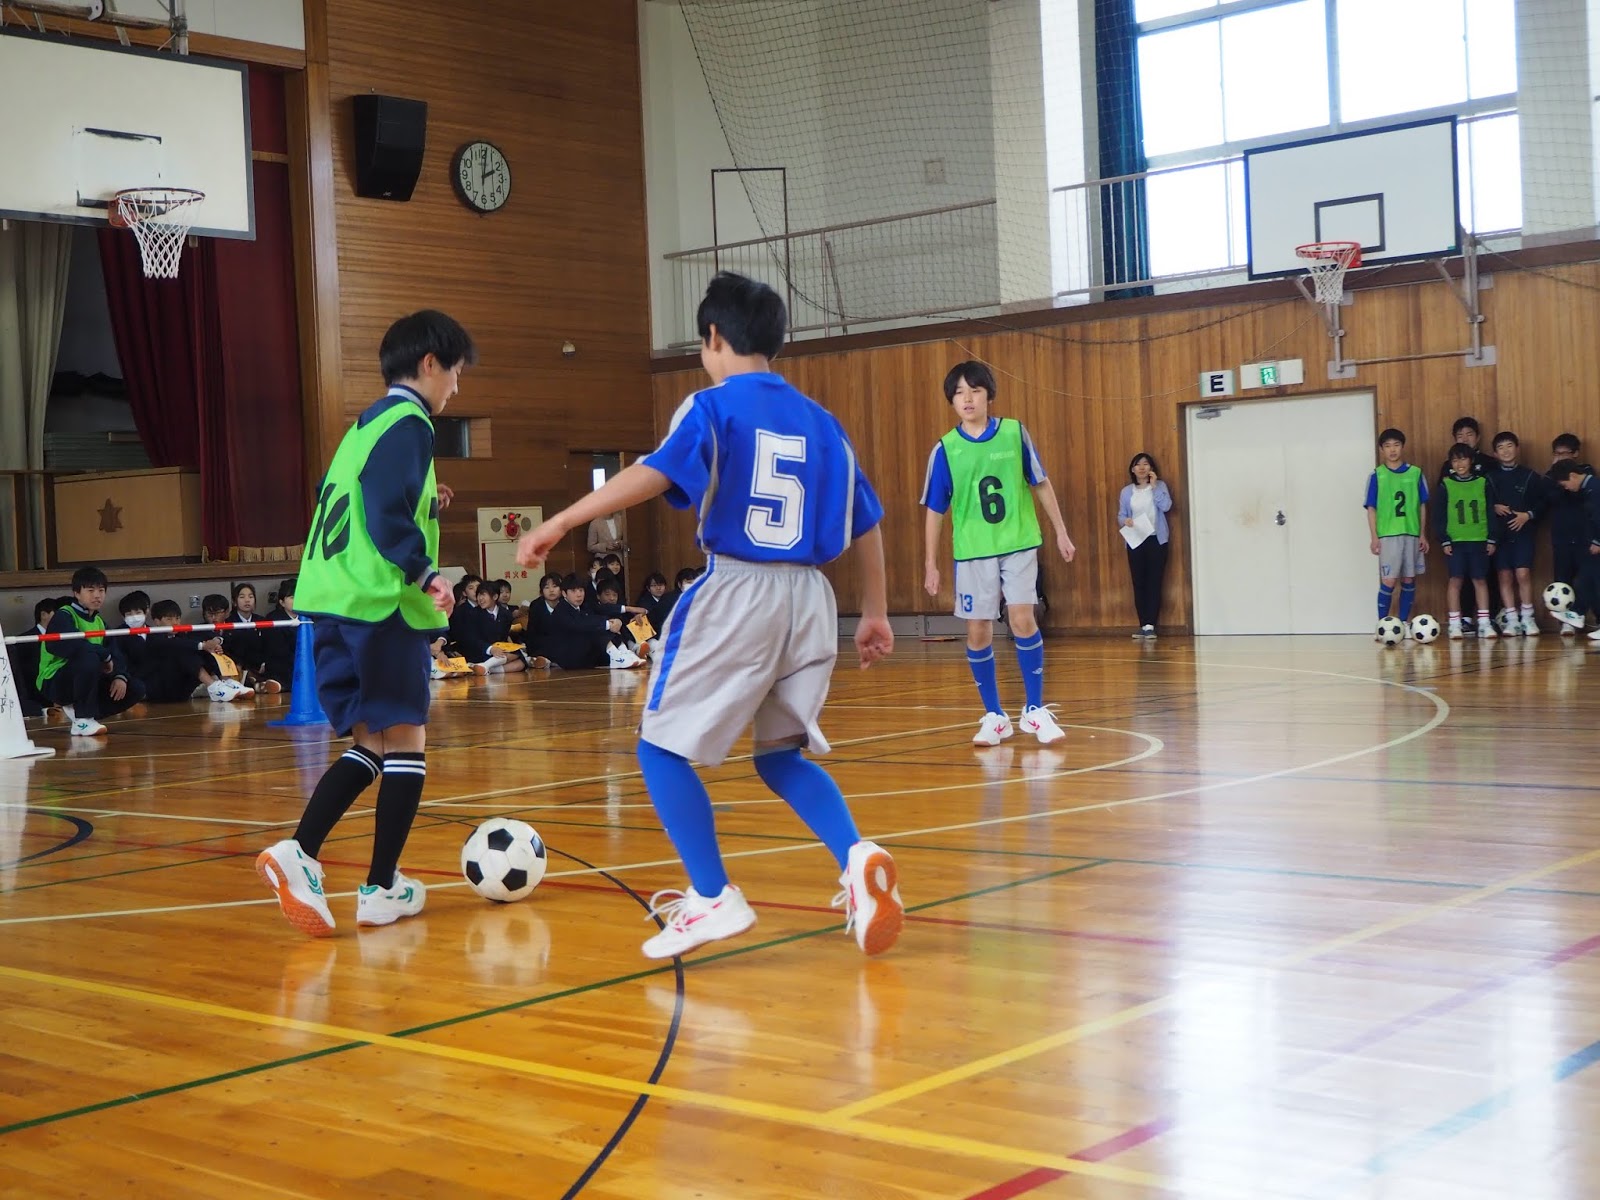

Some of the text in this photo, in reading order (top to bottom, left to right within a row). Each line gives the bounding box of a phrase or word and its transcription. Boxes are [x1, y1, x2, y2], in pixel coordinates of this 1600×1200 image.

[494, 161, 501, 172] 2
[461, 169, 468, 180] 9
[498, 173, 504, 184] 3
[465, 180, 472, 192] 8
[495, 184, 502, 195] 4
[473, 190, 479, 201] 7
[480, 194, 488, 205] 6
[490, 192, 496, 203] 5
[1210, 374, 1225, 393] E
[744, 428, 806, 550] 5
[978, 475, 1006, 525] 6
[1394, 490, 1406, 518] 2
[1454, 499, 1480, 525] 11
[307, 482, 350, 561] 10
[959, 593, 973, 613] 13
